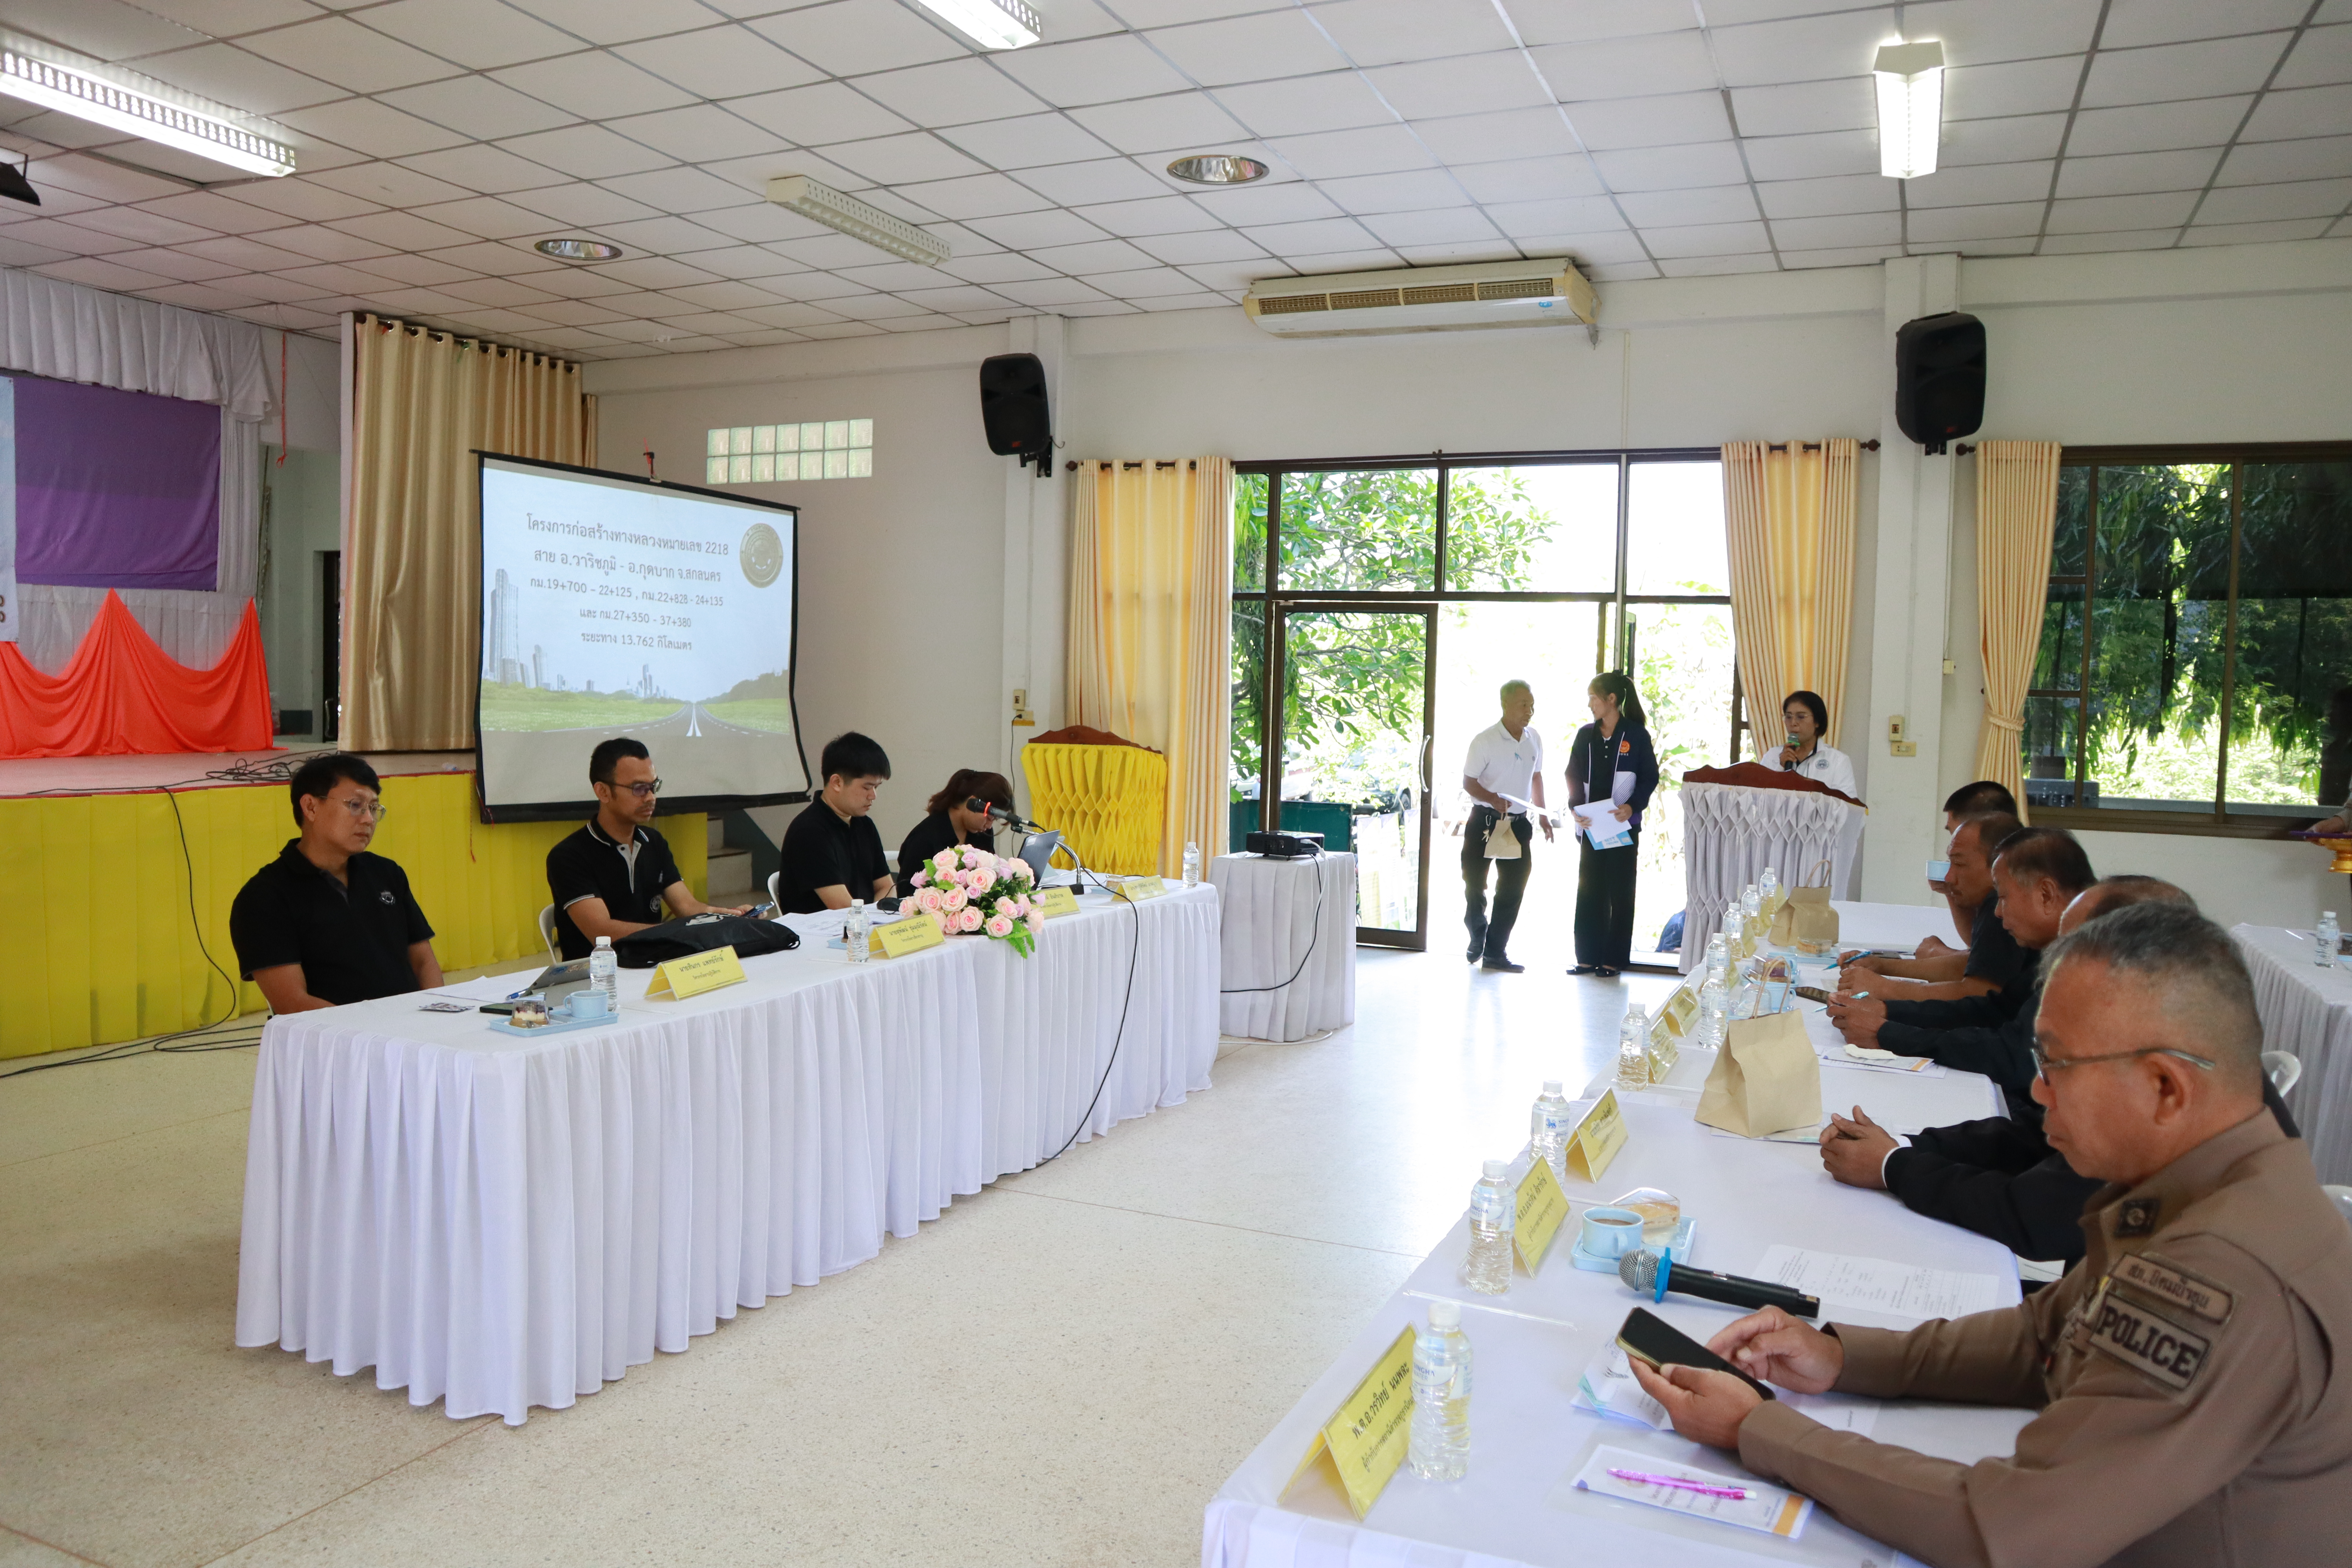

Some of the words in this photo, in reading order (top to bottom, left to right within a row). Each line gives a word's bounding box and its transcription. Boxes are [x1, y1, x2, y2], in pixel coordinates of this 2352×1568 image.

[526, 512, 702, 552] โครงการก่อสร้างทางหลวงหมายเลข
[705, 541, 728, 555] 2218
[534, 550, 555, 563] สาย
[561, 552, 616, 576] อ.วาริชภูมิ
[628, 562, 674, 580] อ.กุดบาก
[677, 568, 721, 582] จ.สกลนคร
[530, 578, 587, 593] กม.19+700
[599, 584, 632, 597] 22+125
[642, 591, 688, 604] กม.22+828
[695, 595, 723, 606] 24+135
[580, 609, 597, 618] และ
[599, 610, 650, 623] กม.27+350
[660, 615, 691, 627] 37+380
[581, 633, 617, 644] ระยะทาง
[621, 634, 654, 647] 13.762
[657, 635, 692, 650] กิโลเมตร
[2097, 1305, 2201, 1380] POLICE
[1352, 1380, 1390, 1440] พ.ต.อ.วรวิทย์
[1389, 1361, 1410, 1391] นนพละ
